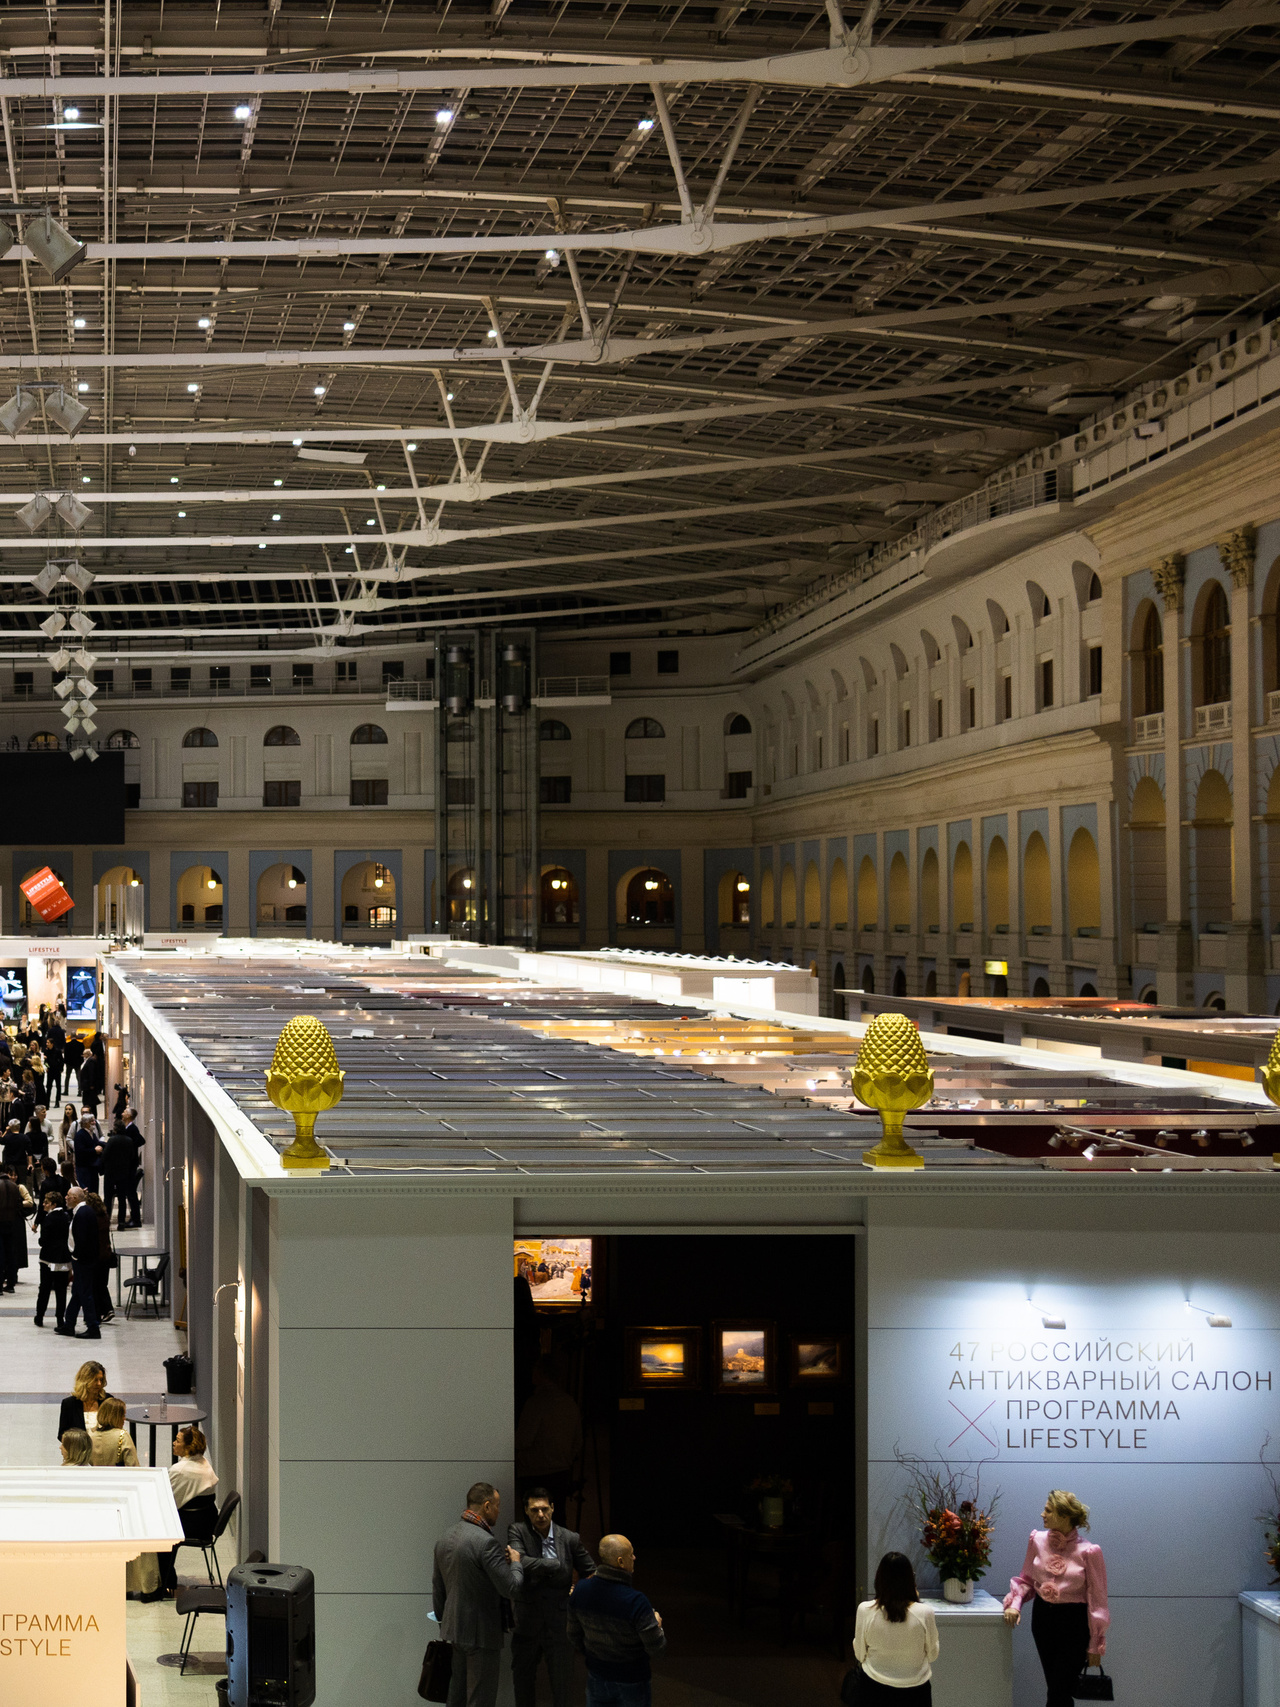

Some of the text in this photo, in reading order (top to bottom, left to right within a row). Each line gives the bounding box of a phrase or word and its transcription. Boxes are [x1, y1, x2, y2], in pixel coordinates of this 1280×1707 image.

[949, 1337, 1194, 1362] 47 РОССИЙСКИЙ
[948, 1366, 1272, 1391] АНТИКВАРНЫЙ САЛОН
[1006, 1400, 1180, 1420] ПРОГРАММА
[1007, 1428, 1148, 1449] LIFESTYLE
